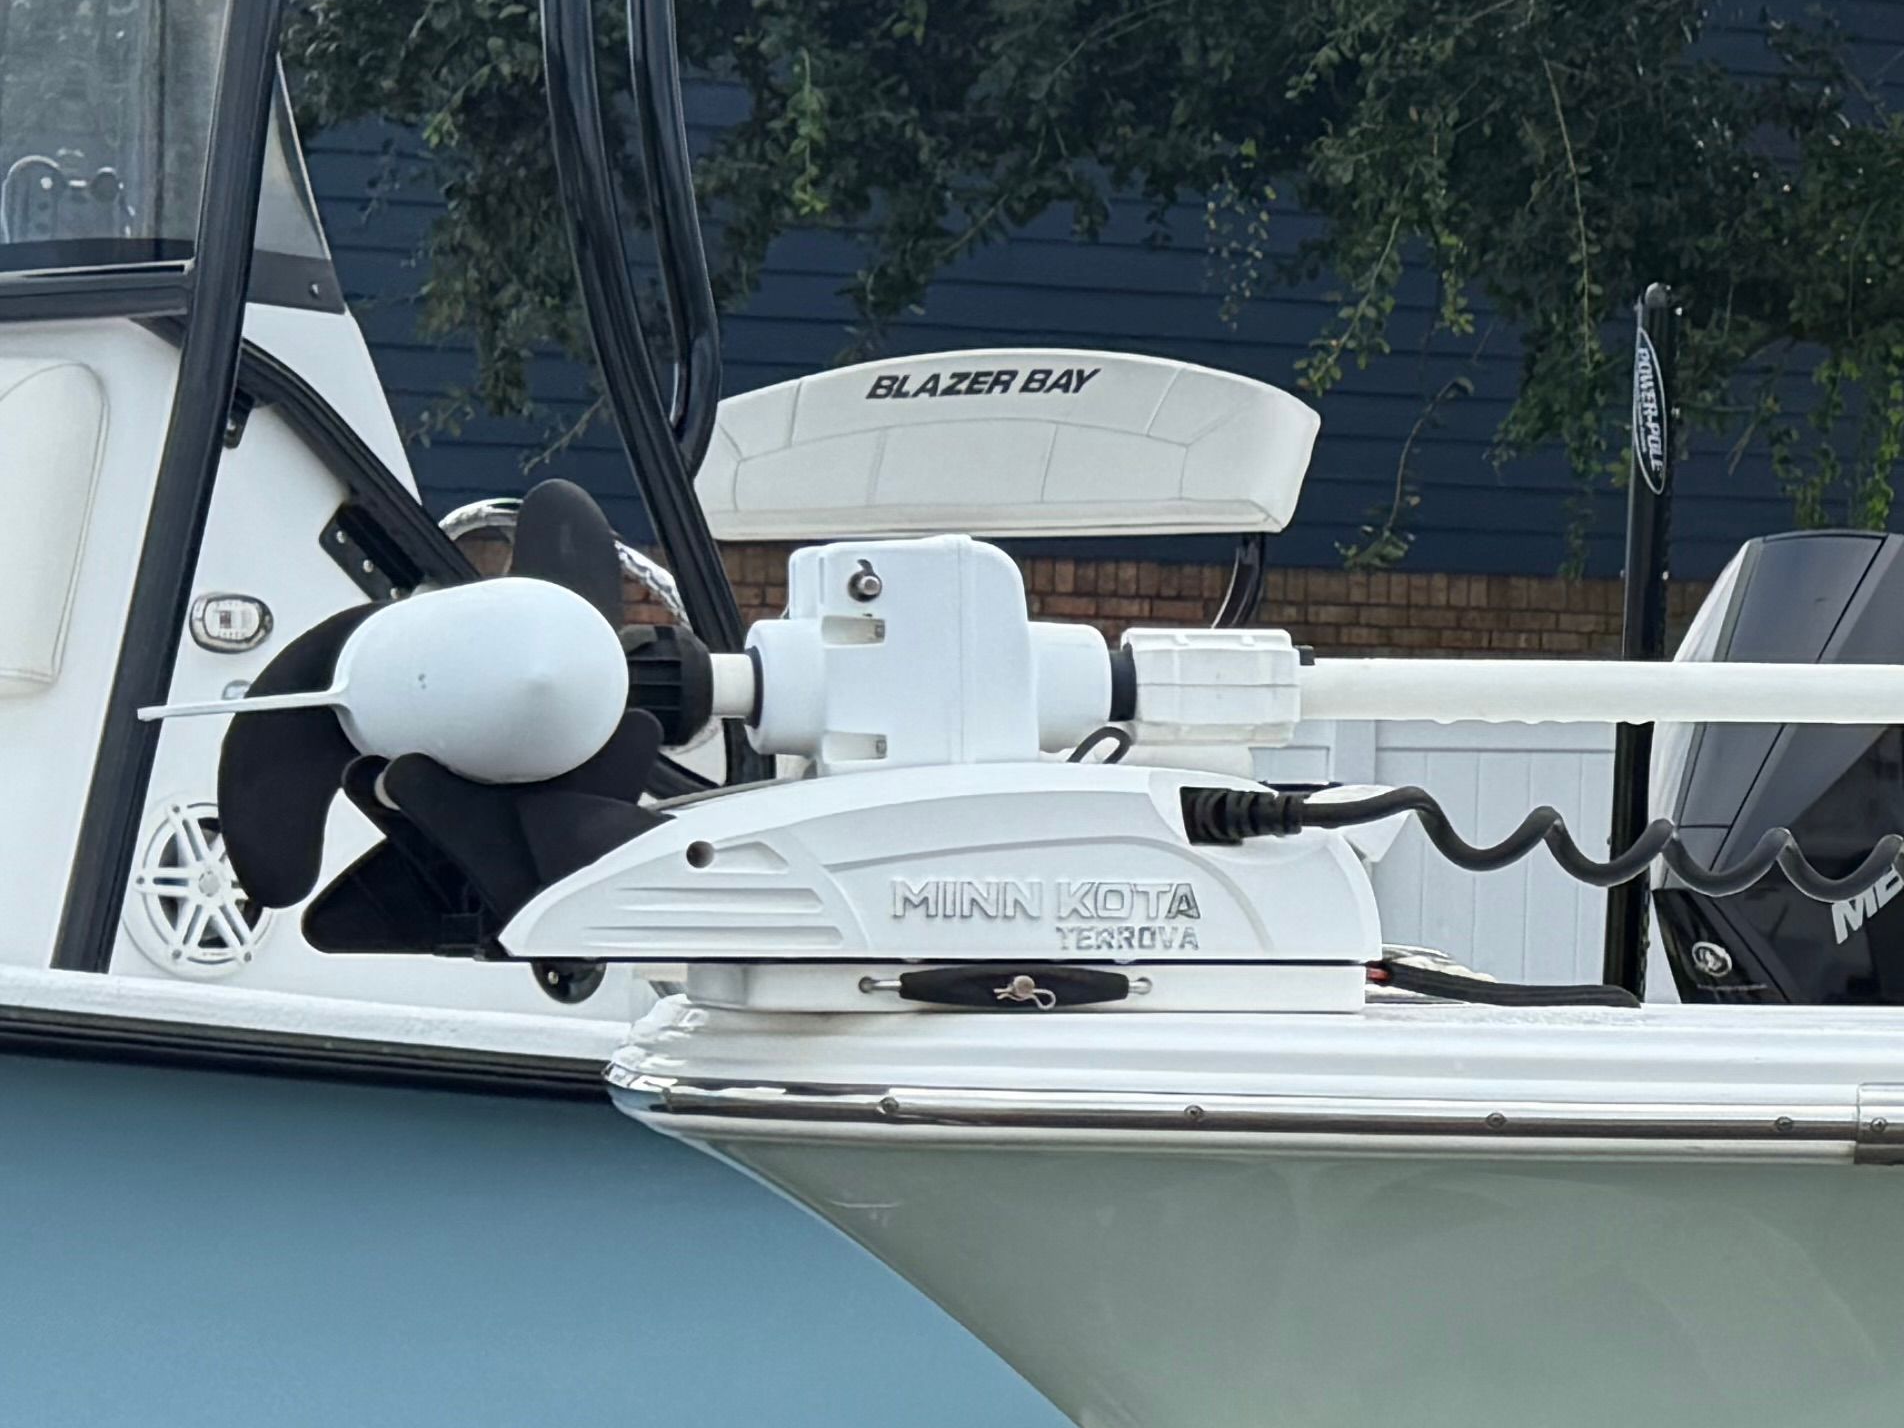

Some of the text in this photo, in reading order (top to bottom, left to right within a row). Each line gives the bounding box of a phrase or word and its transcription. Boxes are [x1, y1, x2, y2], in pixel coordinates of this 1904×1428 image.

[865, 368, 1101, 399] BLAZER BAY
[1638, 348, 1664, 471] POWER-POLE
[892, 881, 1201, 919] MINN KOTA
[1055, 926, 1199, 950] TERROVA
